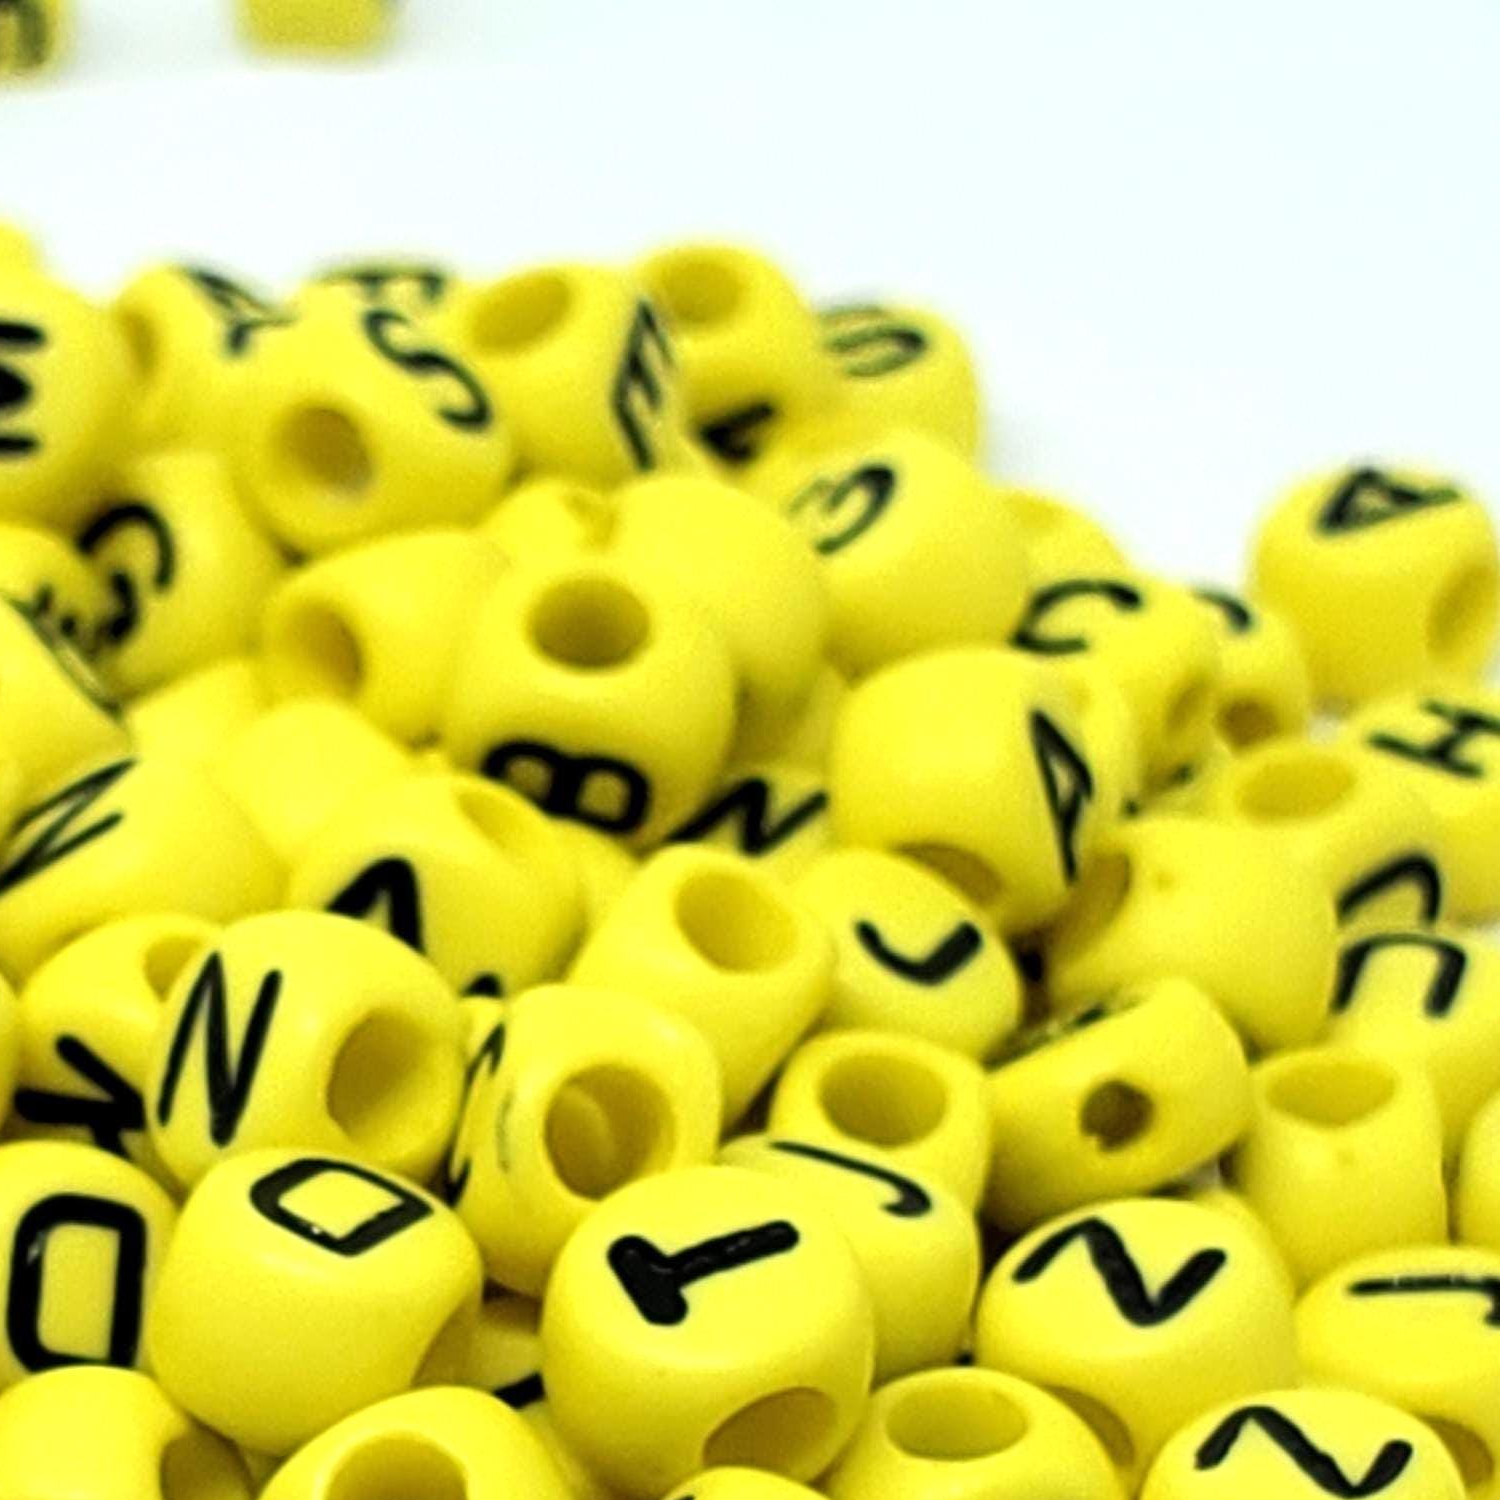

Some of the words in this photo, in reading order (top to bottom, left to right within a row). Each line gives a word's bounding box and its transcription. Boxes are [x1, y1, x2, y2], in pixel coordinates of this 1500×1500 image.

[364, 308, 493, 433] S
[475, 735, 657, 843] B
[1029, 708, 1095, 888] A
[155, 951, 283, 1149] N
[606, 1219, 801, 1327] T
